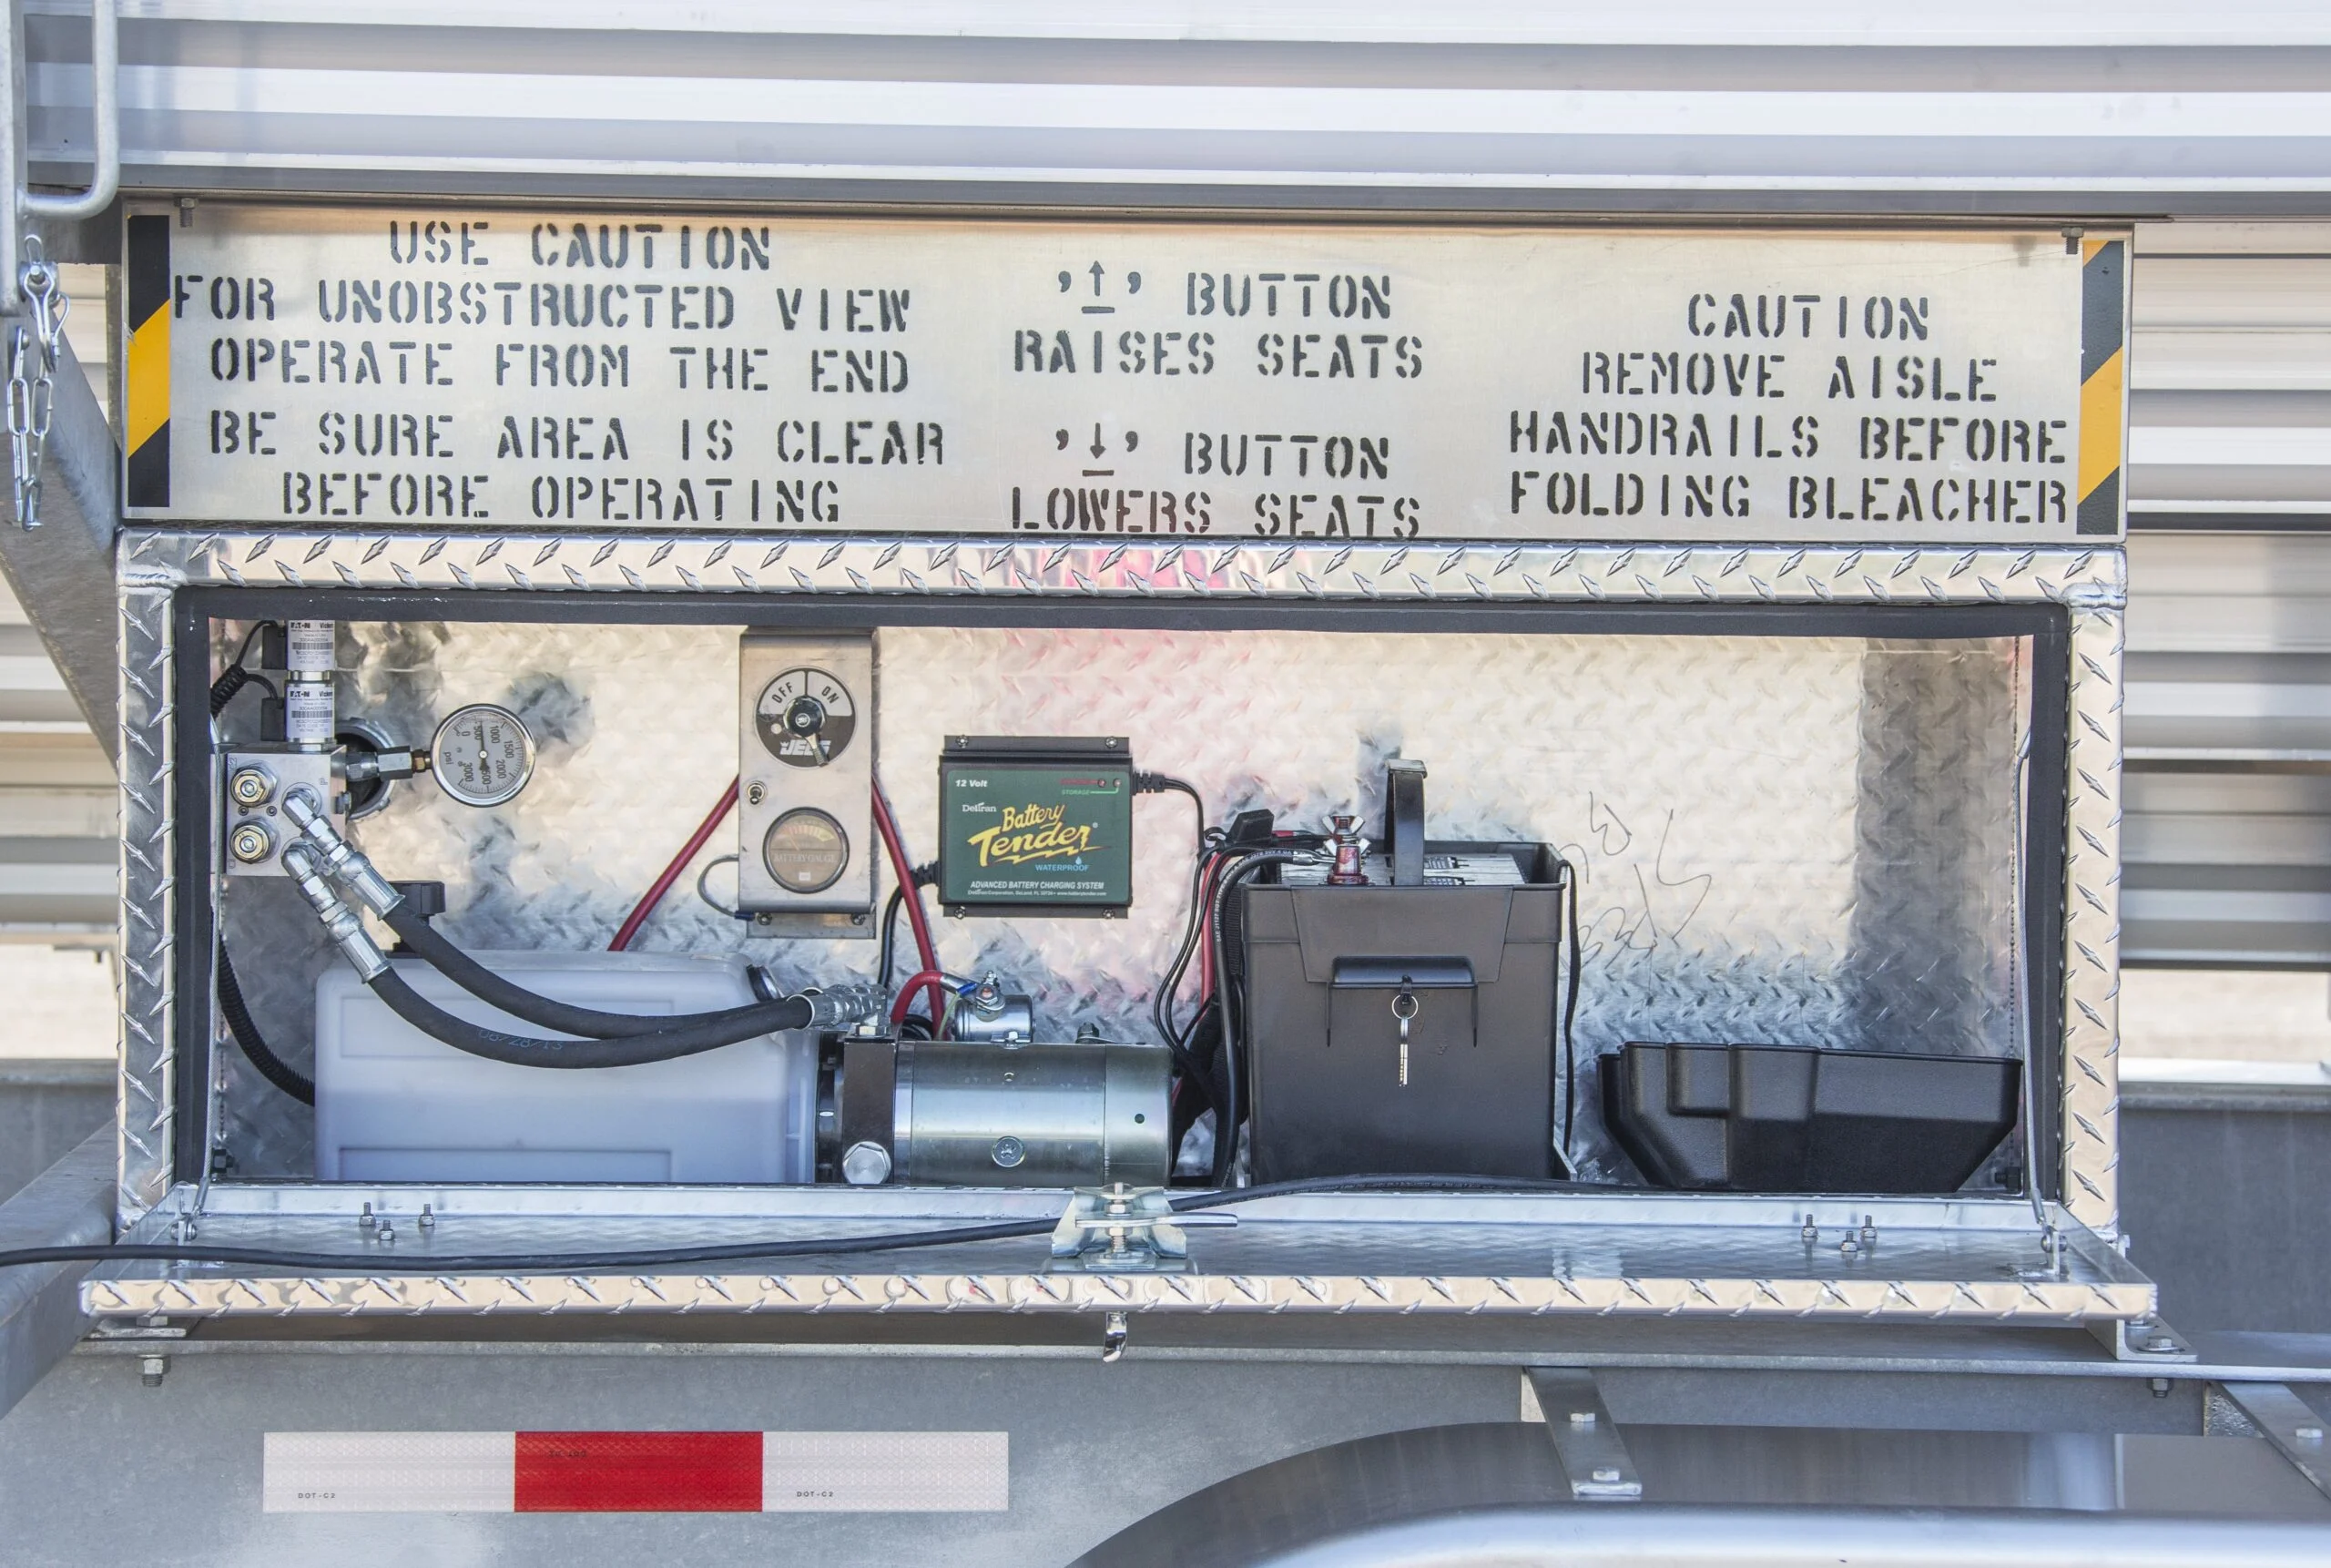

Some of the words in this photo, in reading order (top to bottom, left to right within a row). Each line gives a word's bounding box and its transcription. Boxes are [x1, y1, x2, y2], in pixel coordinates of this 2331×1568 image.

[389, 219, 489, 266] USE
[531, 222, 769, 270] CAUTION
[174, 274, 275, 321] FOR
[318, 280, 734, 330] UNOBSTRUCTED
[776, 288, 910, 333] VIEW
[1186, 272, 1390, 320] BUTTON
[1687, 293, 1929, 341] CAUTION
[209, 337, 453, 386] OPERATE
[496, 343, 628, 388] FROM
[669, 346, 769, 392] THE
[811, 349, 909, 393] END
[1014, 330, 1215, 376] RAISES
[1257, 333, 1422, 379] SEATS
[1583, 351, 1786, 398] REMOVE
[1827, 355, 1997, 402] AISLE
[210, 409, 277, 455] BE
[319, 412, 453, 458] SURE
[497, 415, 629, 461] AREA
[682, 419, 733, 461] IS
[777, 420, 943, 465] CLEAR
[1185, 432, 1389, 480] BUTTON
[1510, 410, 1819, 458] HANDRAILS
[1860, 416, 2067, 464] BEFORE
[283, 472, 489, 518] BEFORE
[532, 475, 840, 523] OPERATING
[1012, 486, 1211, 534] LOWERS
[1254, 493, 1420, 537] SEATS
[1511, 470, 1750, 518] FOLDING
[1788, 475, 2066, 524] BLEACHER
[771, 682, 793, 704] OFF
[821, 686, 840, 704] ON
[490, 725, 500, 744] 1000
[504, 740, 514, 759] 1500
[463, 762, 473, 782] 3000
[482, 768, 492, 785] 500
[495, 759, 506, 779] 2000
[955, 779, 967, 787] 12
[969, 779, 988, 788] Volt
[1002, 803, 1066, 832] Battery
[966, 821, 1092, 868] Tender
[1034, 864, 1089, 872] WATERPROOF
[970, 881, 1008, 889] ADVANCED
[1008, 881, 1040, 890] BATTERY
[1040, 881, 1076, 890] CHARGING
[1076, 881, 1104, 890] SYSTEM
